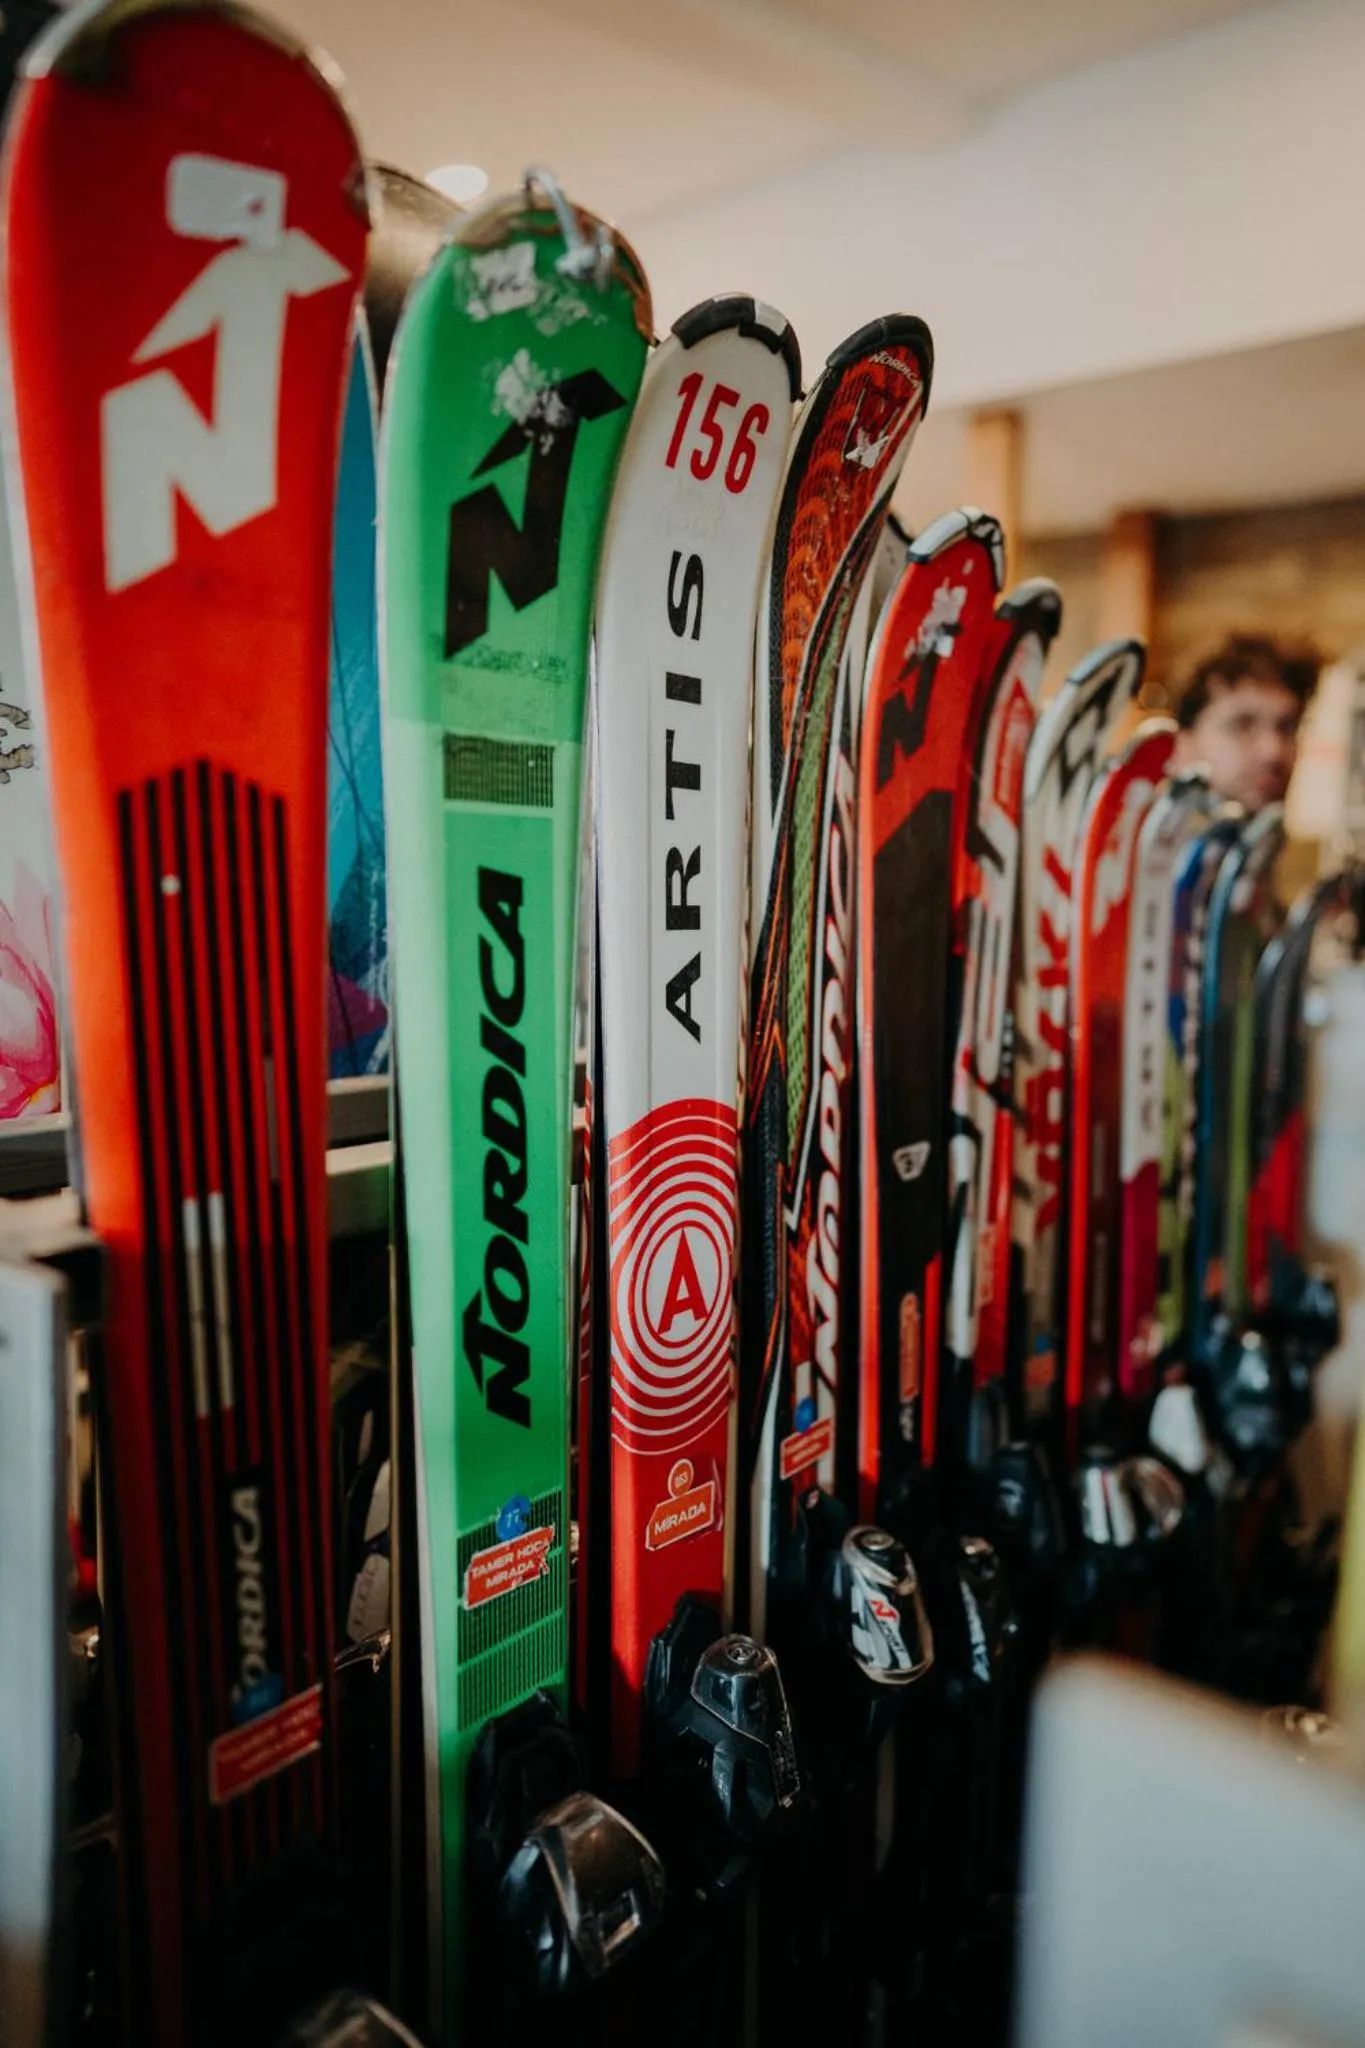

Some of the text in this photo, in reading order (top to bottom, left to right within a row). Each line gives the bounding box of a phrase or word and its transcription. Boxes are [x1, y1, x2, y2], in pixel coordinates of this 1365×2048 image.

[664, 371, 770, 494] 156
[868, 350, 921, 390] NORDICA
[665, 549, 705, 1044] ARTIS
[463, 864, 531, 1430] NORDICA
[657, 1227, 708, 1335] A
[231, 1487, 268, 1704] ORDICA
